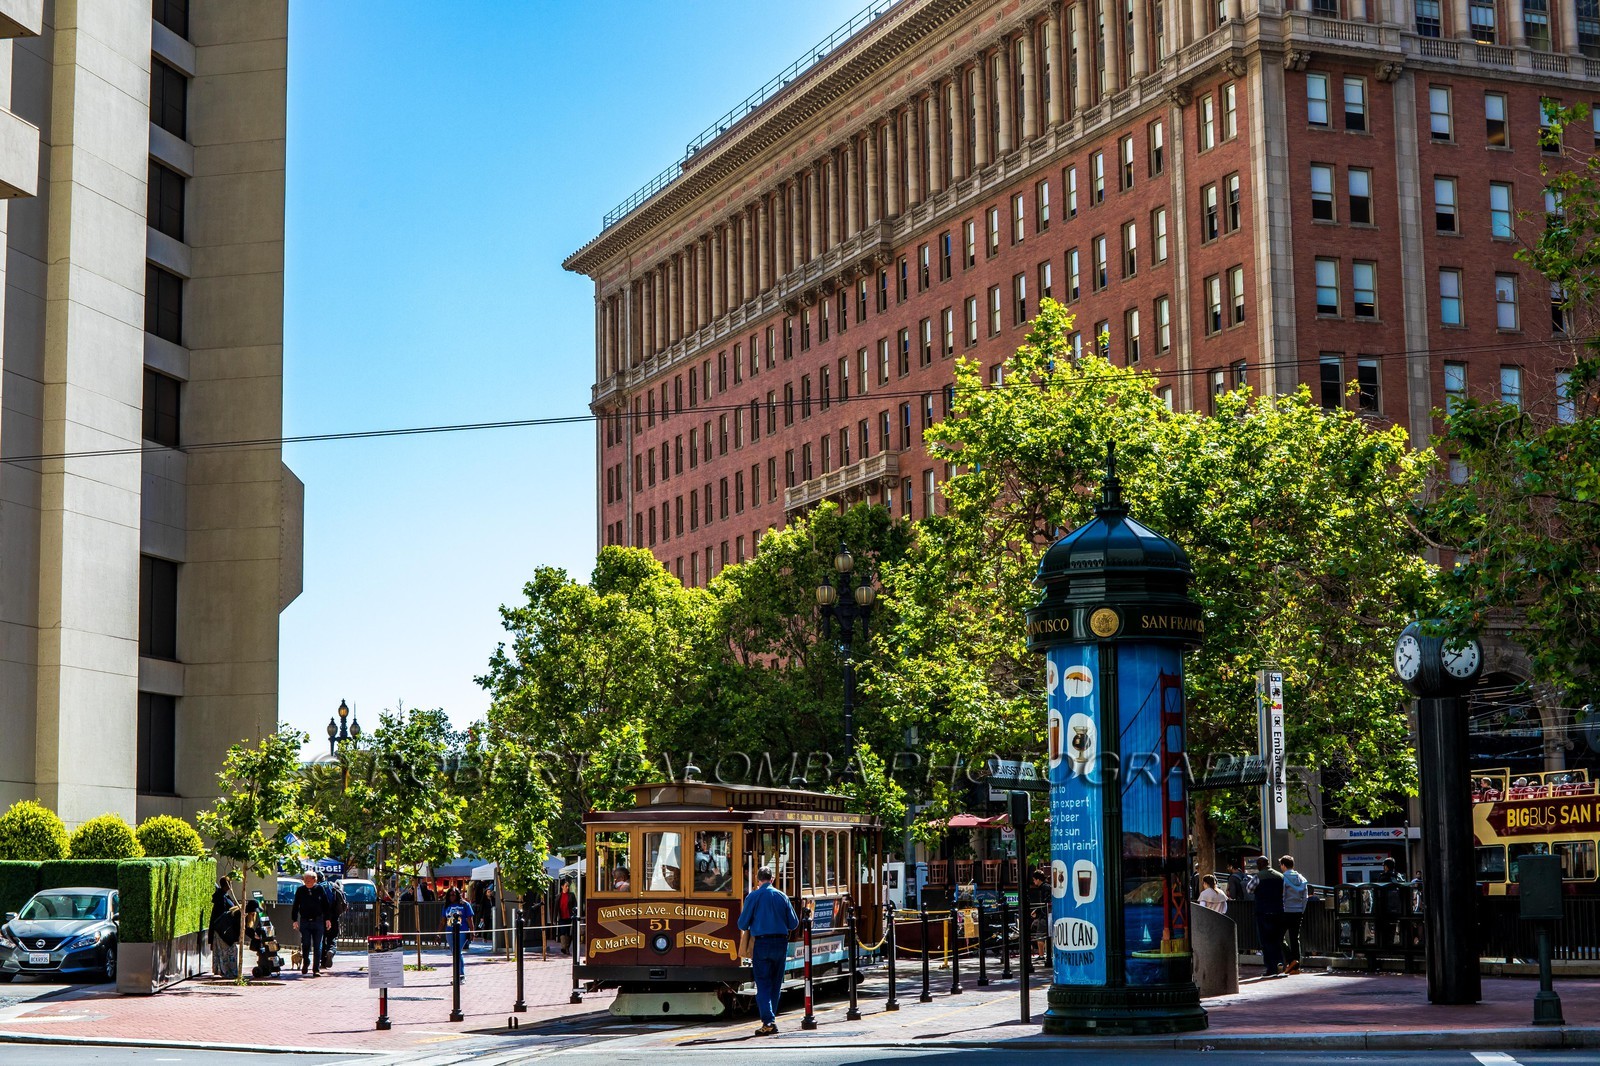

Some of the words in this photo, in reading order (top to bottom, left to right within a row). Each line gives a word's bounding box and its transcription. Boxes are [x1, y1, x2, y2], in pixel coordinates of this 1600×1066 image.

[1141, 614, 1168, 629] SAN
[1273, 731, 1283, 803] Embarcadero
[1061, 796, 1089, 809] expert
[1060, 812, 1080, 822] beer
[1560, 803, 1591, 824] SAN
[1064, 828, 1080, 836] sun
[1072, 839, 1098, 851] rain?
[600, 909, 618, 919] Van
[618, 905, 643, 917] Ness
[674, 905, 727, 920] California
[649, 918, 672, 931] 51
[595, 940, 603, 949] &
[604, 935, 640, 949] Market
[685, 934, 730, 950] Streets
[1071, 922, 1096, 947] CAN.
[1060, 951, 1095, 967] PORTLAND
